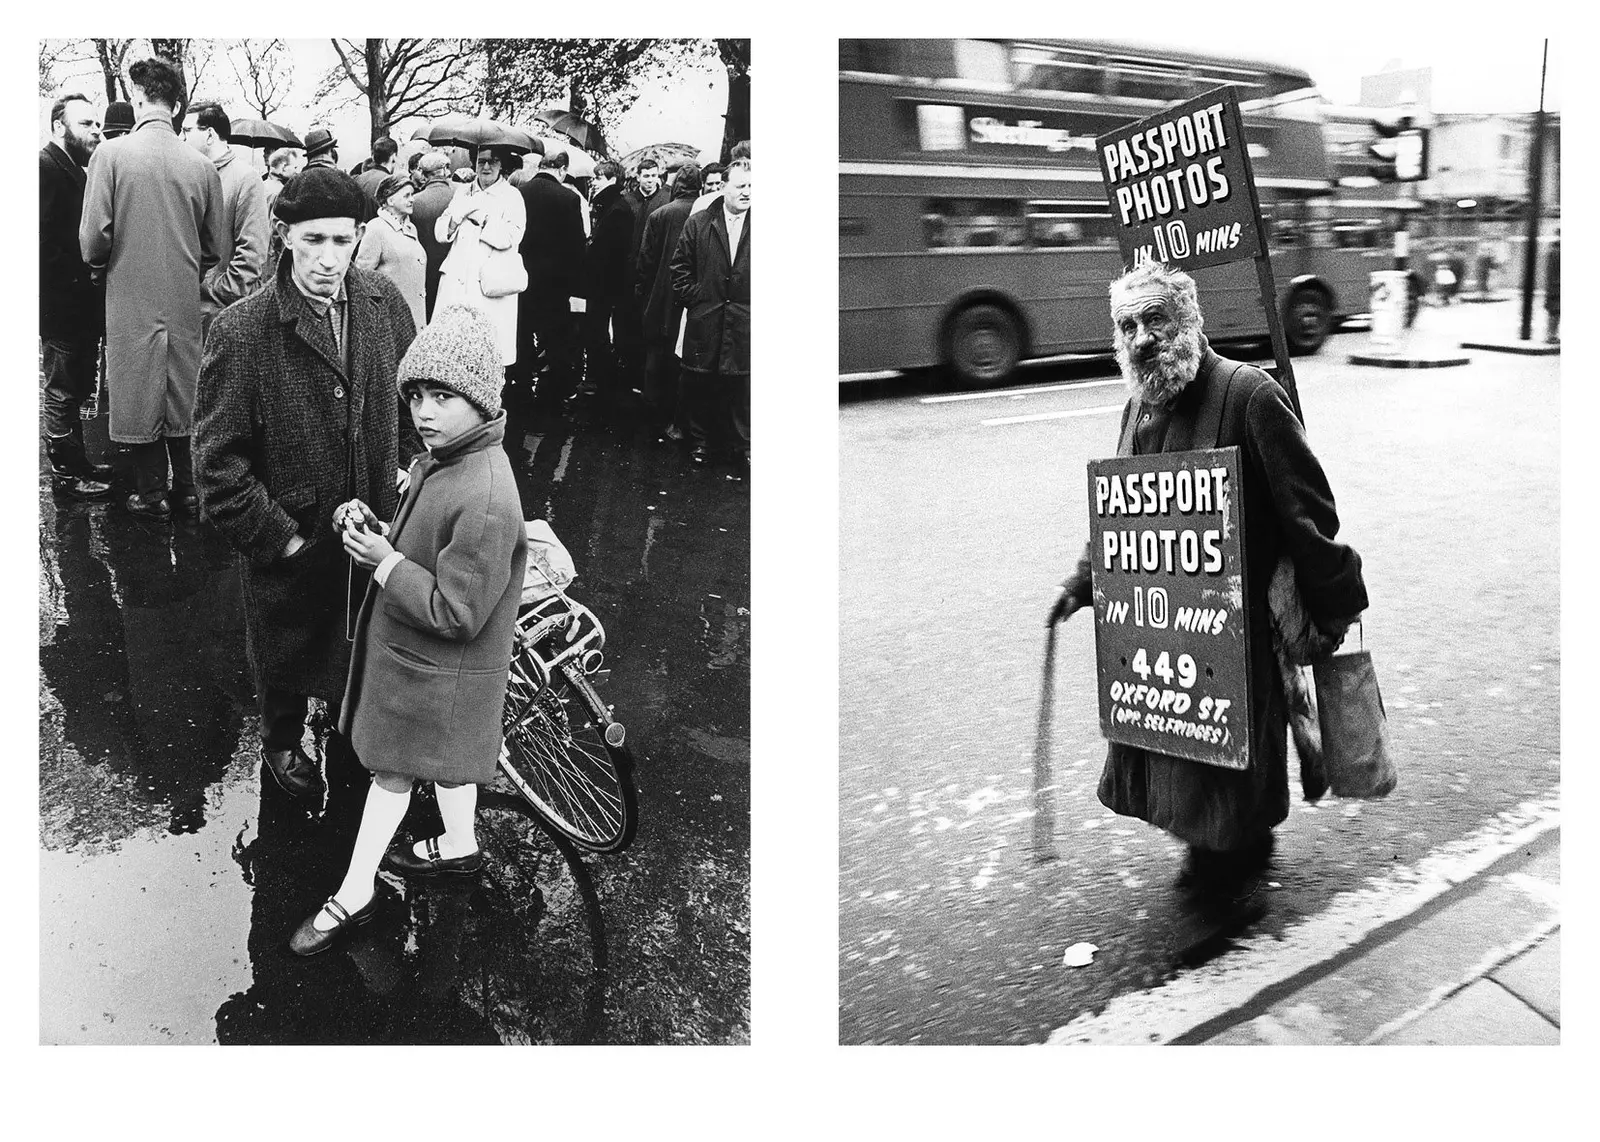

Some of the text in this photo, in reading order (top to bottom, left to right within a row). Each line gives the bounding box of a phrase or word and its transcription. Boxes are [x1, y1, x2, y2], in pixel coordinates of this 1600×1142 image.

[1103, 102, 1227, 183] PASSPORT
[1116, 155, 1229, 226] PHOTOS
[1133, 219, 1242, 268] IN 10 MINS
[1095, 467, 1227, 515] PASSPORT
[1103, 529, 1222, 573] PHOTOS
[1106, 586, 1228, 636] IN 10 MINS
[1132, 648, 1197, 688] 449
[1110, 680, 1231, 724] OXFORD ST.
